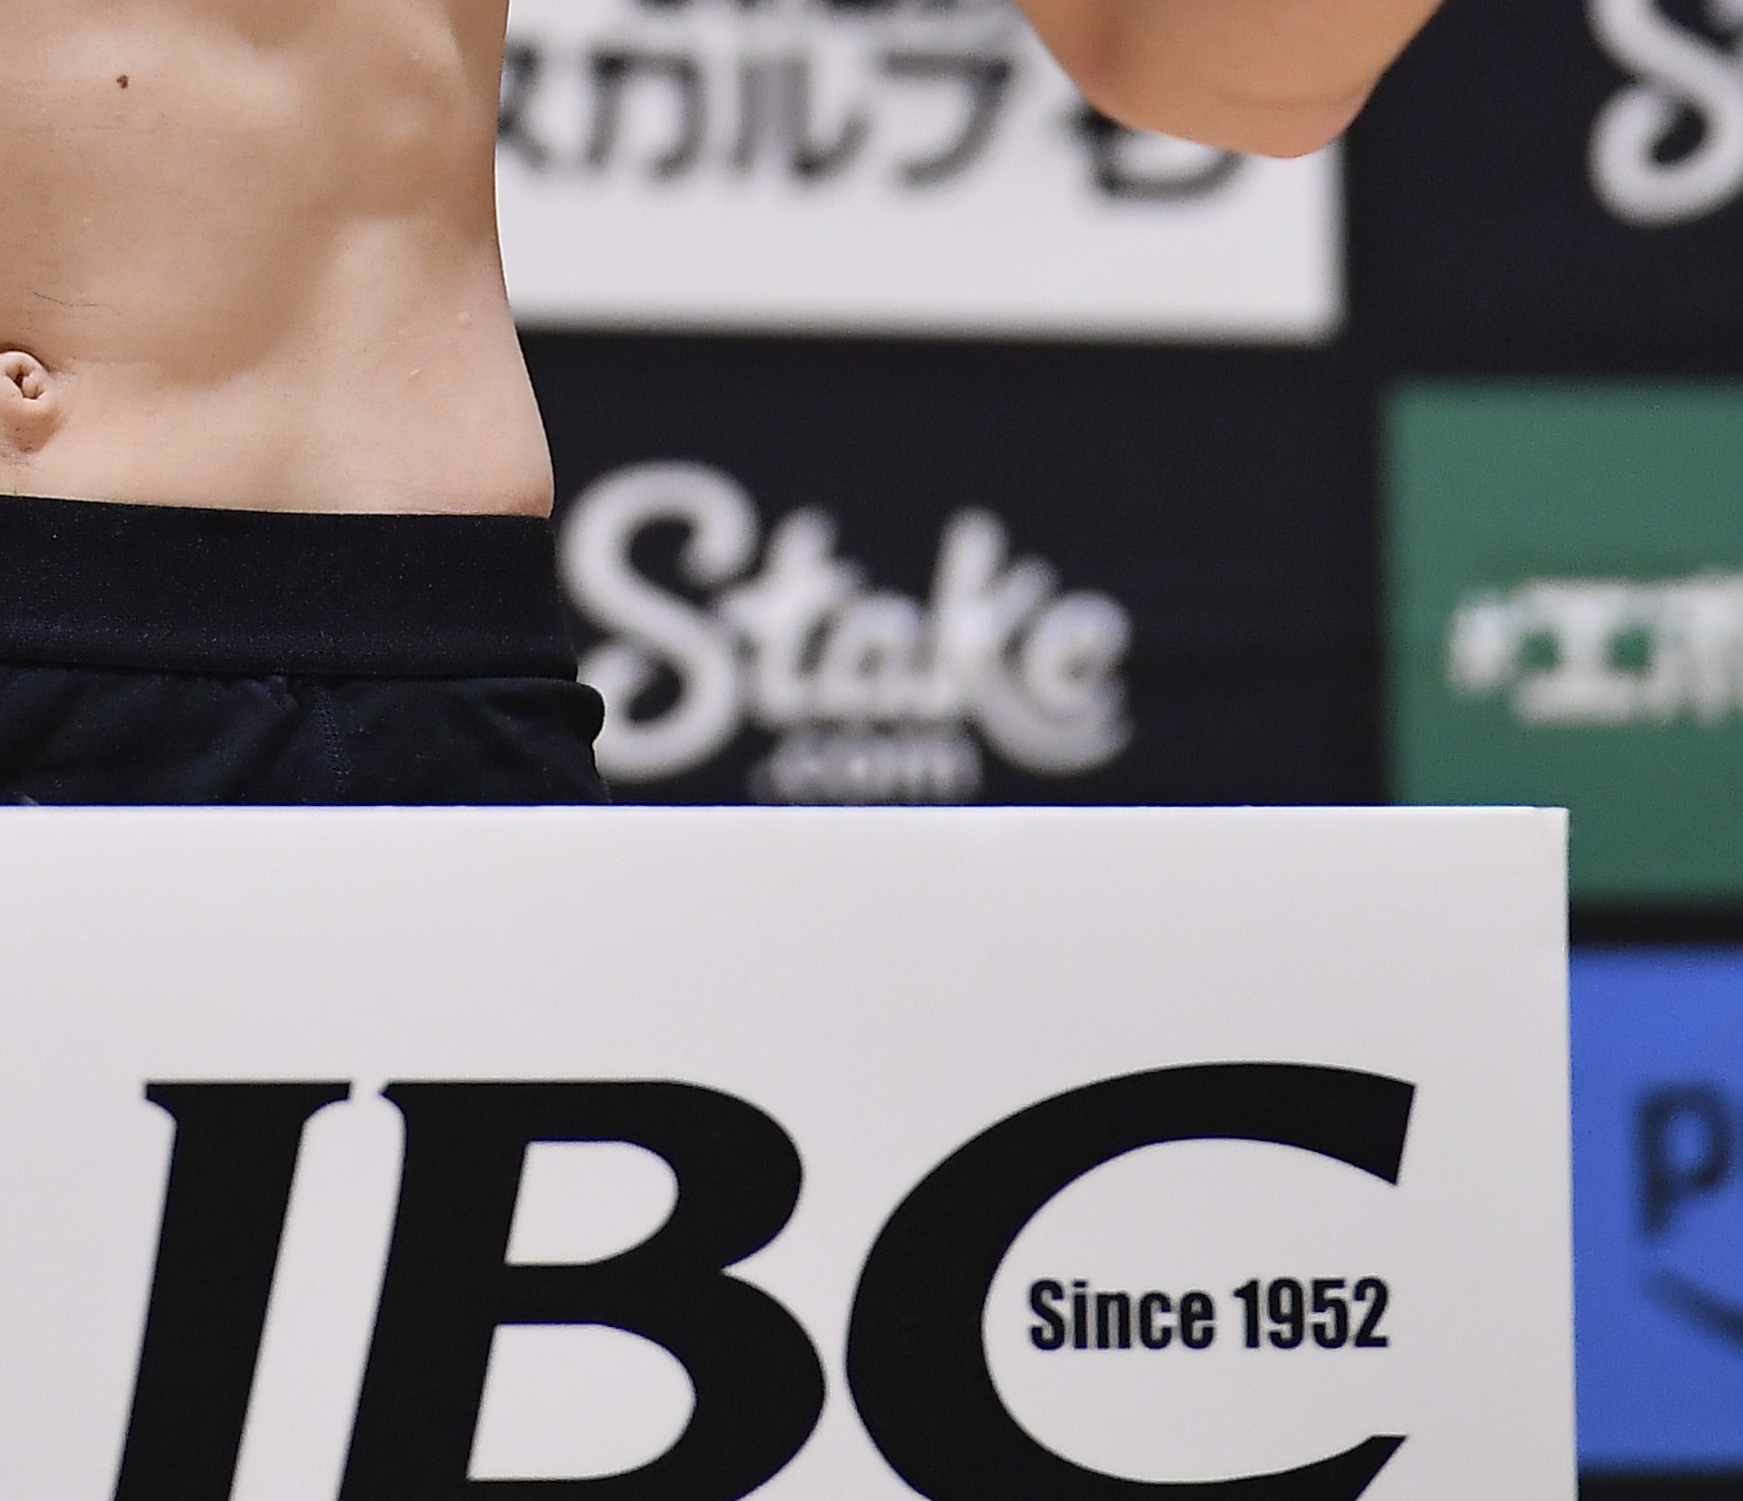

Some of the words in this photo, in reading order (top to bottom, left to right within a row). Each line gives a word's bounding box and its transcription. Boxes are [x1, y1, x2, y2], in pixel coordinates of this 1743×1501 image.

[560, 464, 1127, 776] Stake
[1027, 1278, 1217, 1353] Since
[1232, 1276, 1390, 1351] 1952
